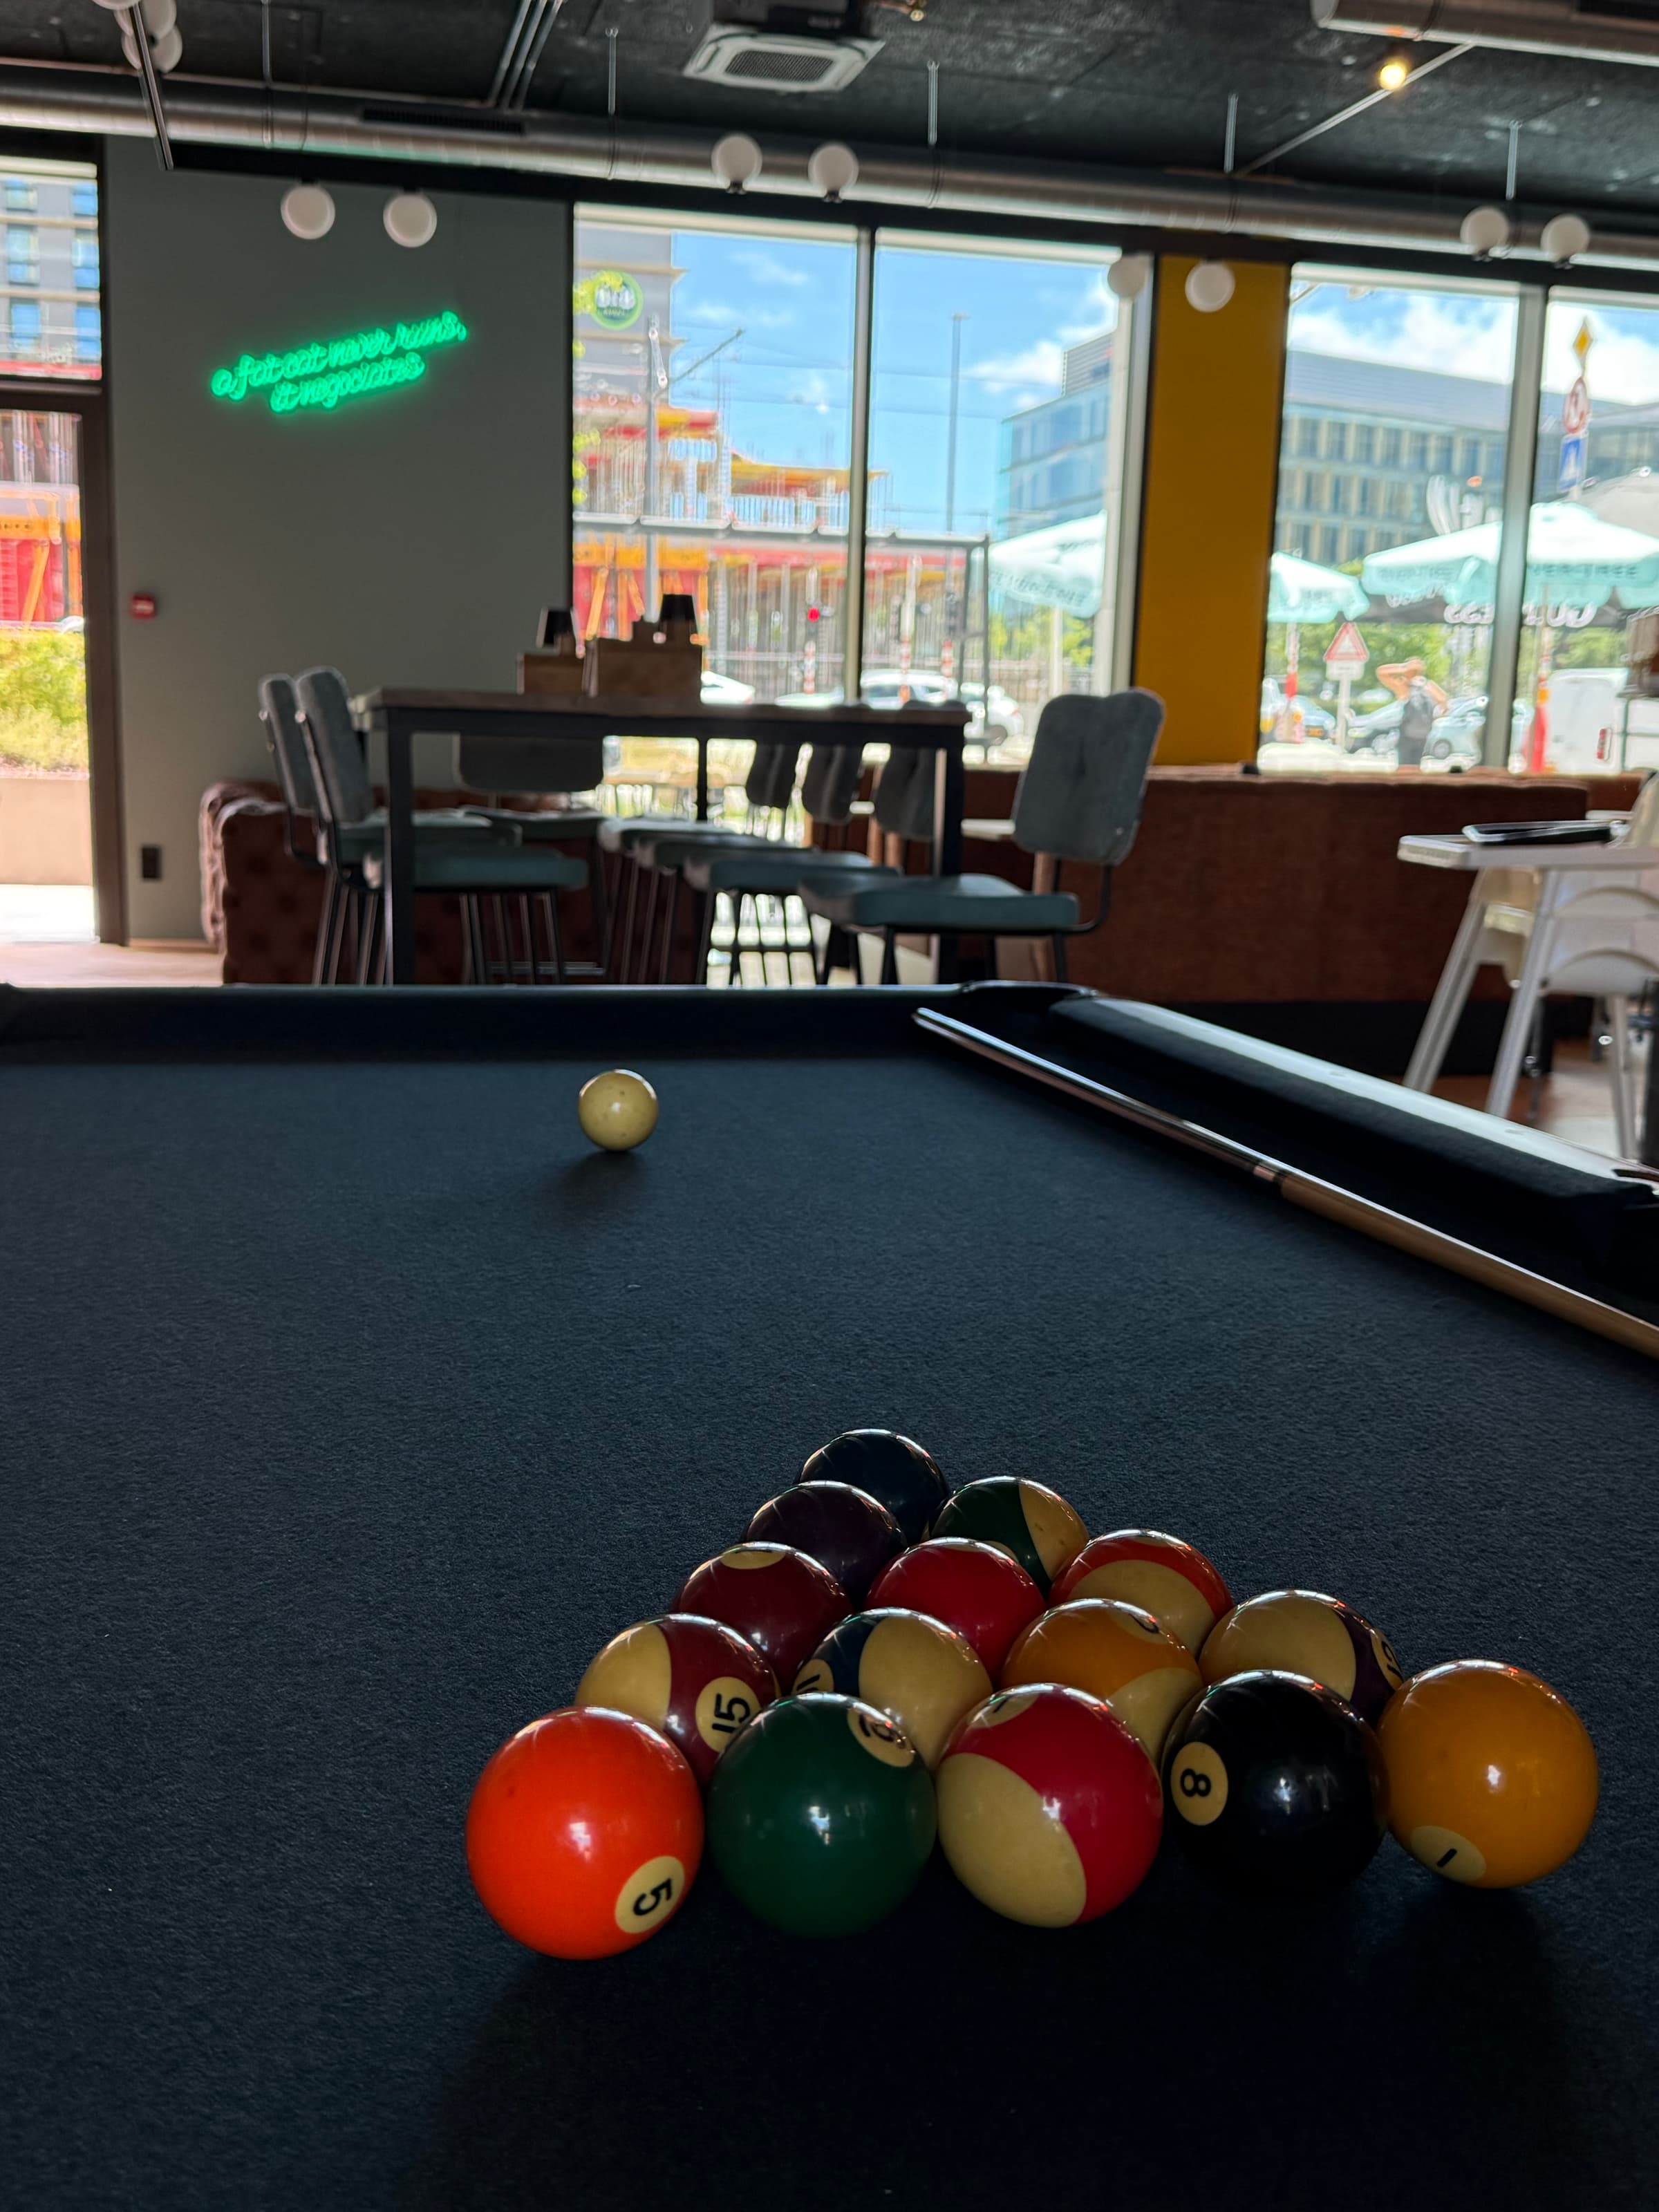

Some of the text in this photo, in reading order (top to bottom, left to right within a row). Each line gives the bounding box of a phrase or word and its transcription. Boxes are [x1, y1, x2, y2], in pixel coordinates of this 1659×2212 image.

[711, 1693, 751, 1734] 15
[1179, 1768, 1212, 1798] 8
[1436, 1848, 1457, 1868] 1
[632, 1877, 672, 1915] 5
